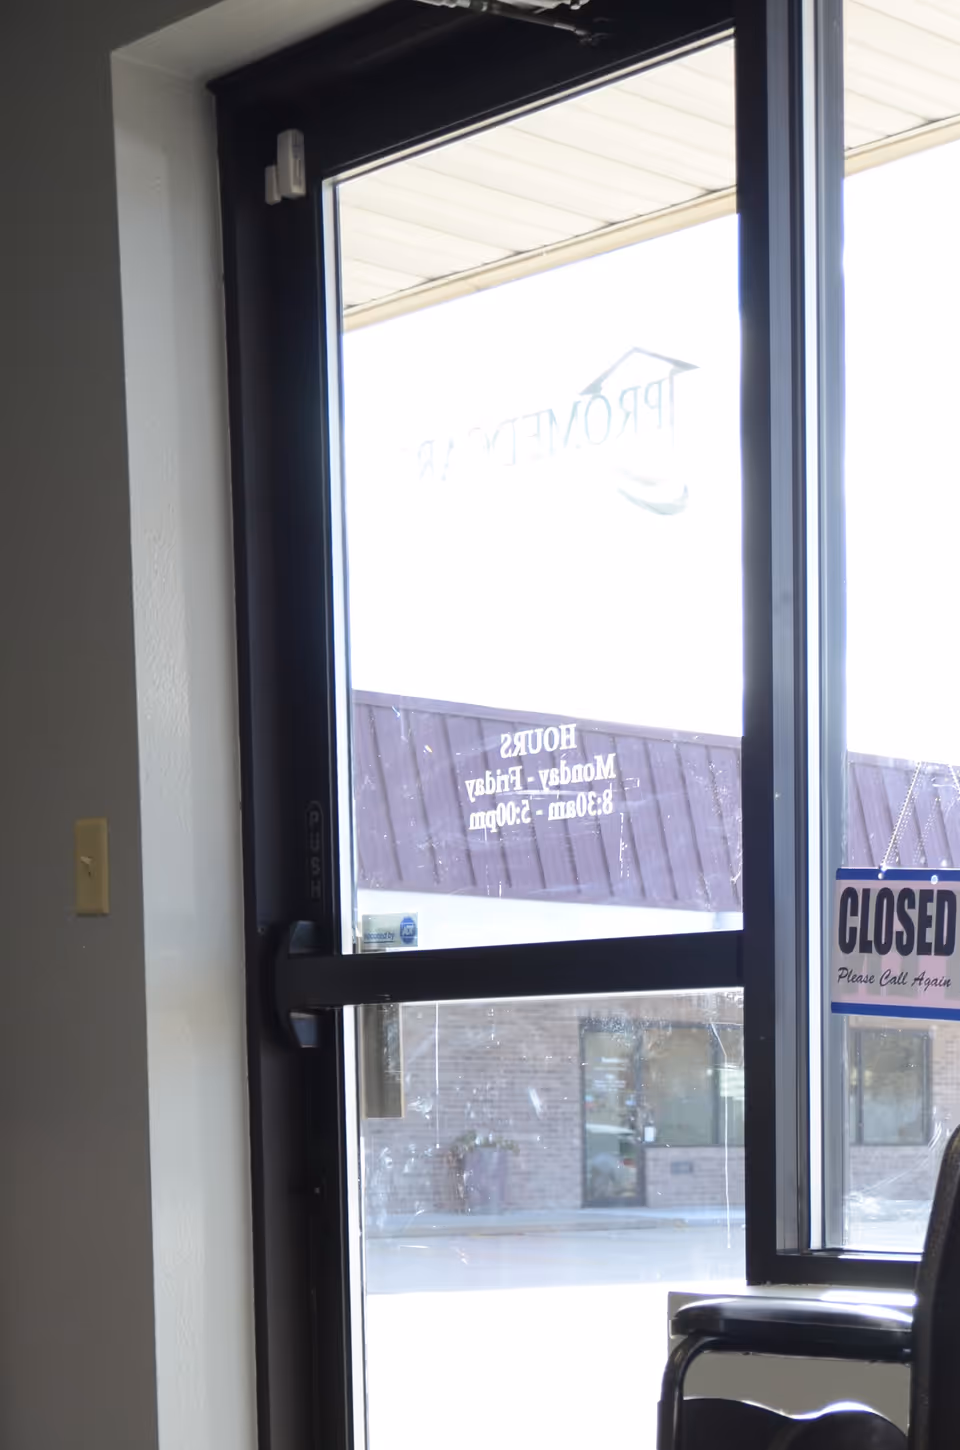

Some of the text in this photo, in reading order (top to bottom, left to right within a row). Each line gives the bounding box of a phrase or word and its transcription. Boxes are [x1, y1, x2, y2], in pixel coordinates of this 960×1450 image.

[309, 810, 321, 898] PUSH
[838, 886, 957, 957] CLOSED
[837, 967, 952, 991] Please Call Again
